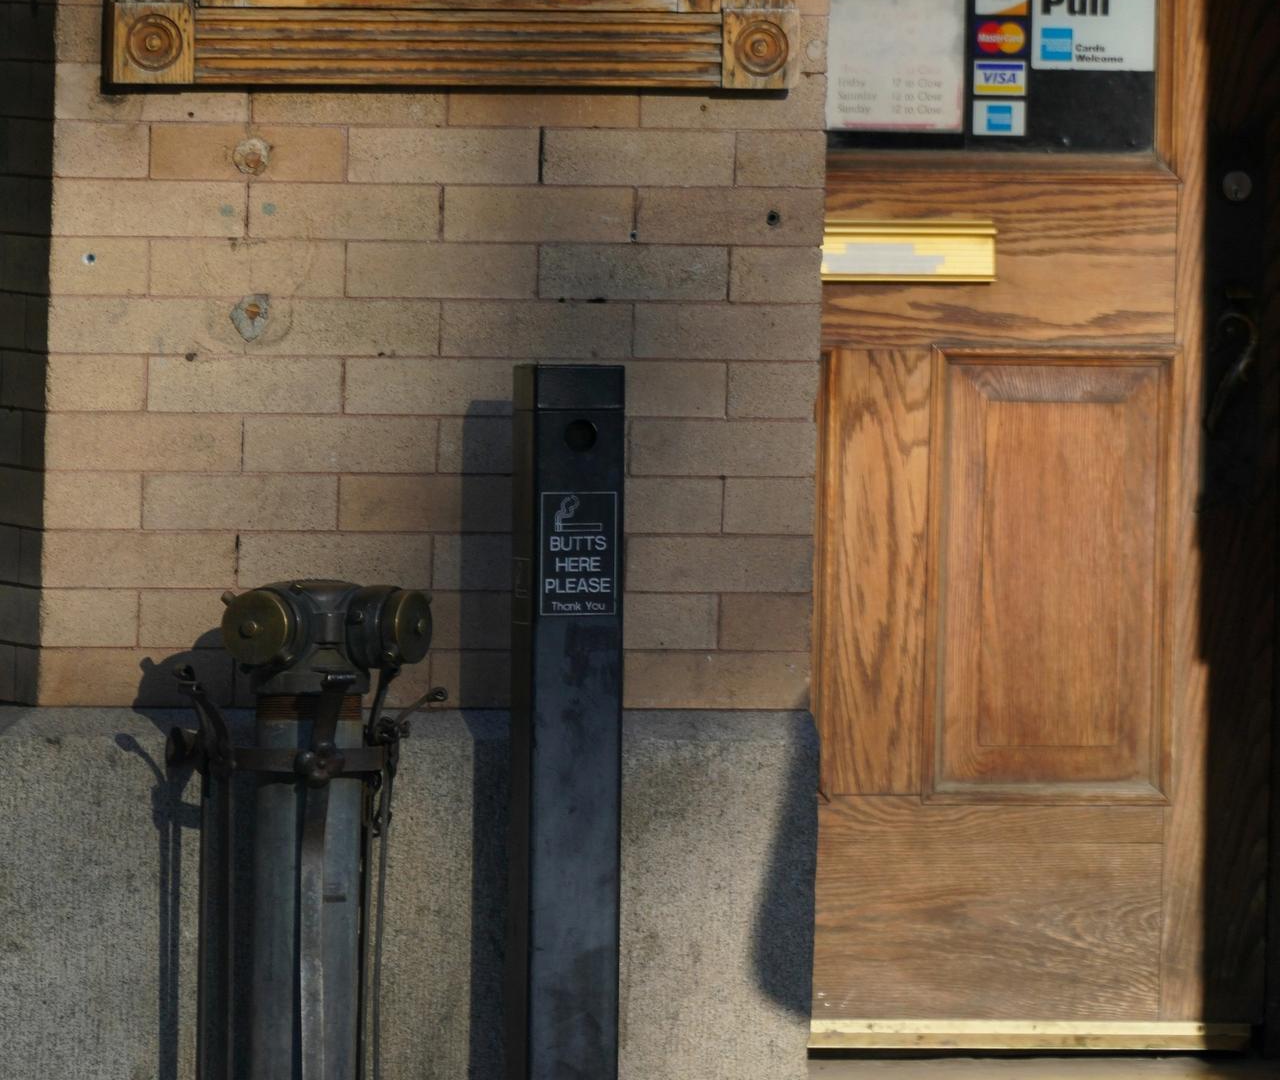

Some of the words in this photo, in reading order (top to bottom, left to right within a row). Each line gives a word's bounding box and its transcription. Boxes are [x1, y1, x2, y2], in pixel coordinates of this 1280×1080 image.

[1075, 44, 1105, 52] Cards
[1075, 54, 1123, 63] Welcome
[983, 72, 1017, 85] VISA
[549, 536, 607, 551] BUTTS
[555, 557, 601, 572] HERE
[545, 578, 611, 593] PLEASE
[551, 601, 581, 611] Thank
[585, 602, 605, 610] You
